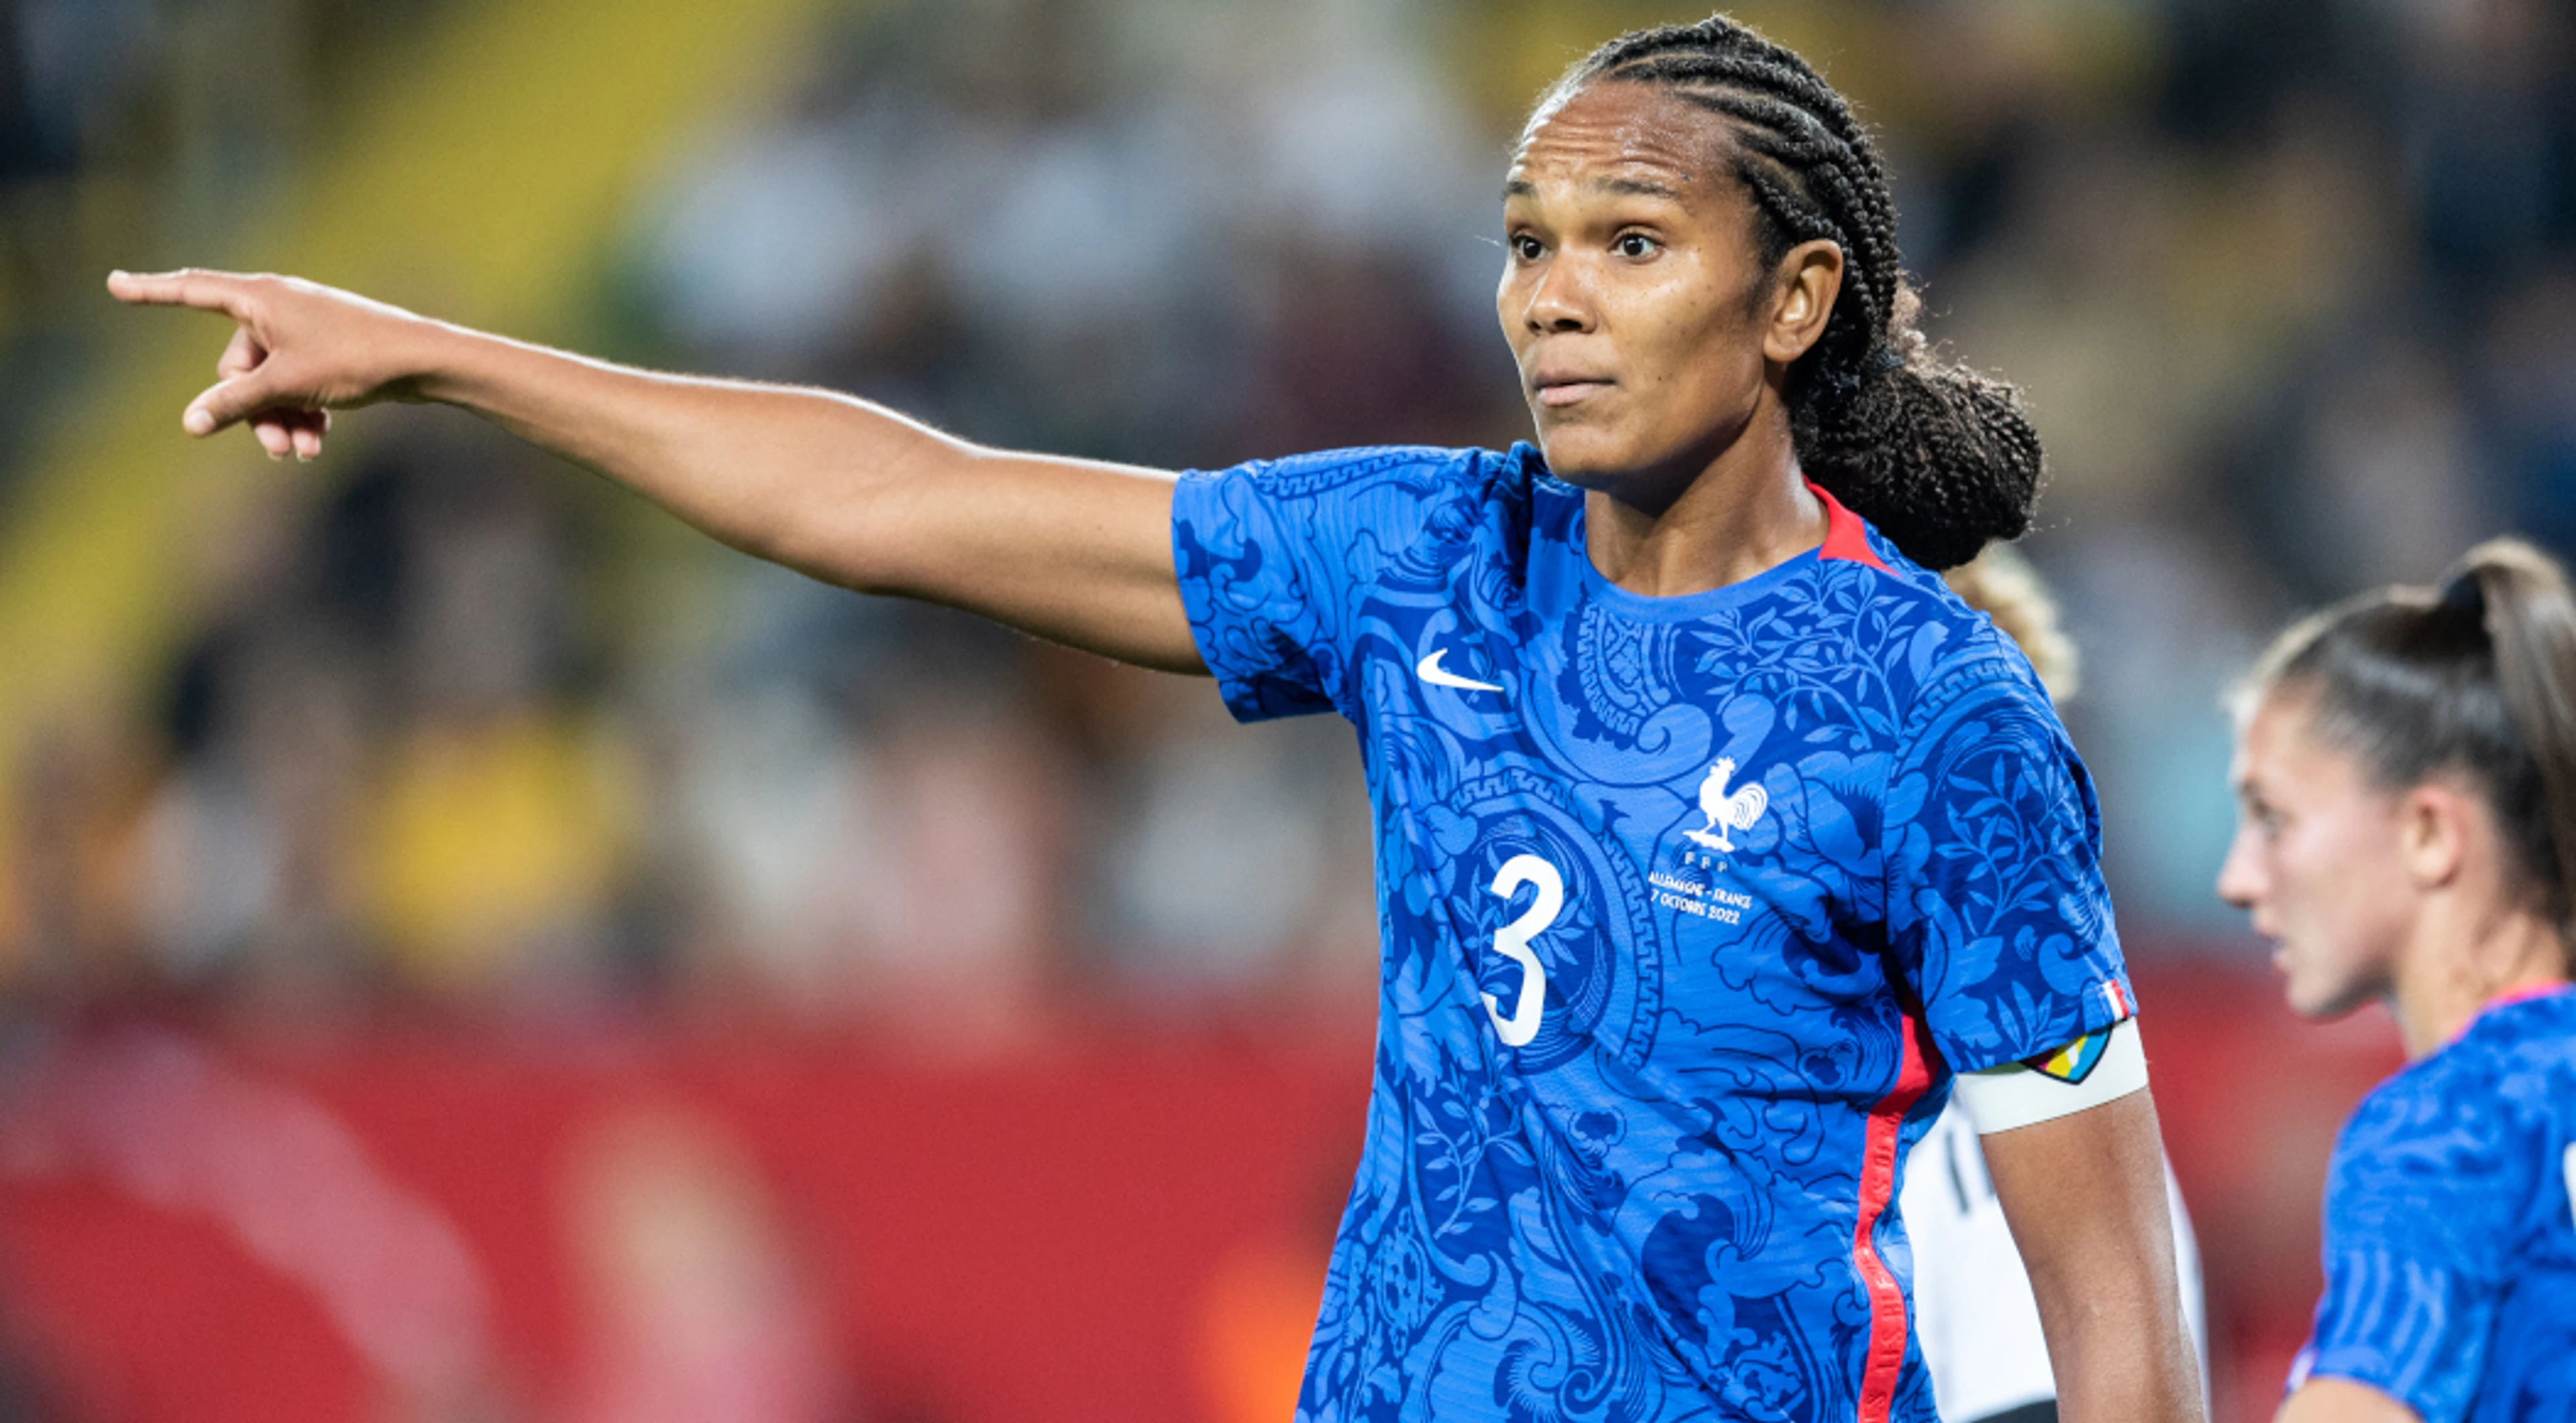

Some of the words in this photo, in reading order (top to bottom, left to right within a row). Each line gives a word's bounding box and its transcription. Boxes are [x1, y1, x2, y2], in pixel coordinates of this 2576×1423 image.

[1648, 871, 1706, 898] ALLEMAGNE
[1713, 888, 1752, 910] FRANCE
[1650, 889, 1660, 902] 7
[1660, 893, 1707, 916] OCTOBRE
[1707, 905, 1740, 926] 2022
[1479, 853, 1564, 1047] 3
